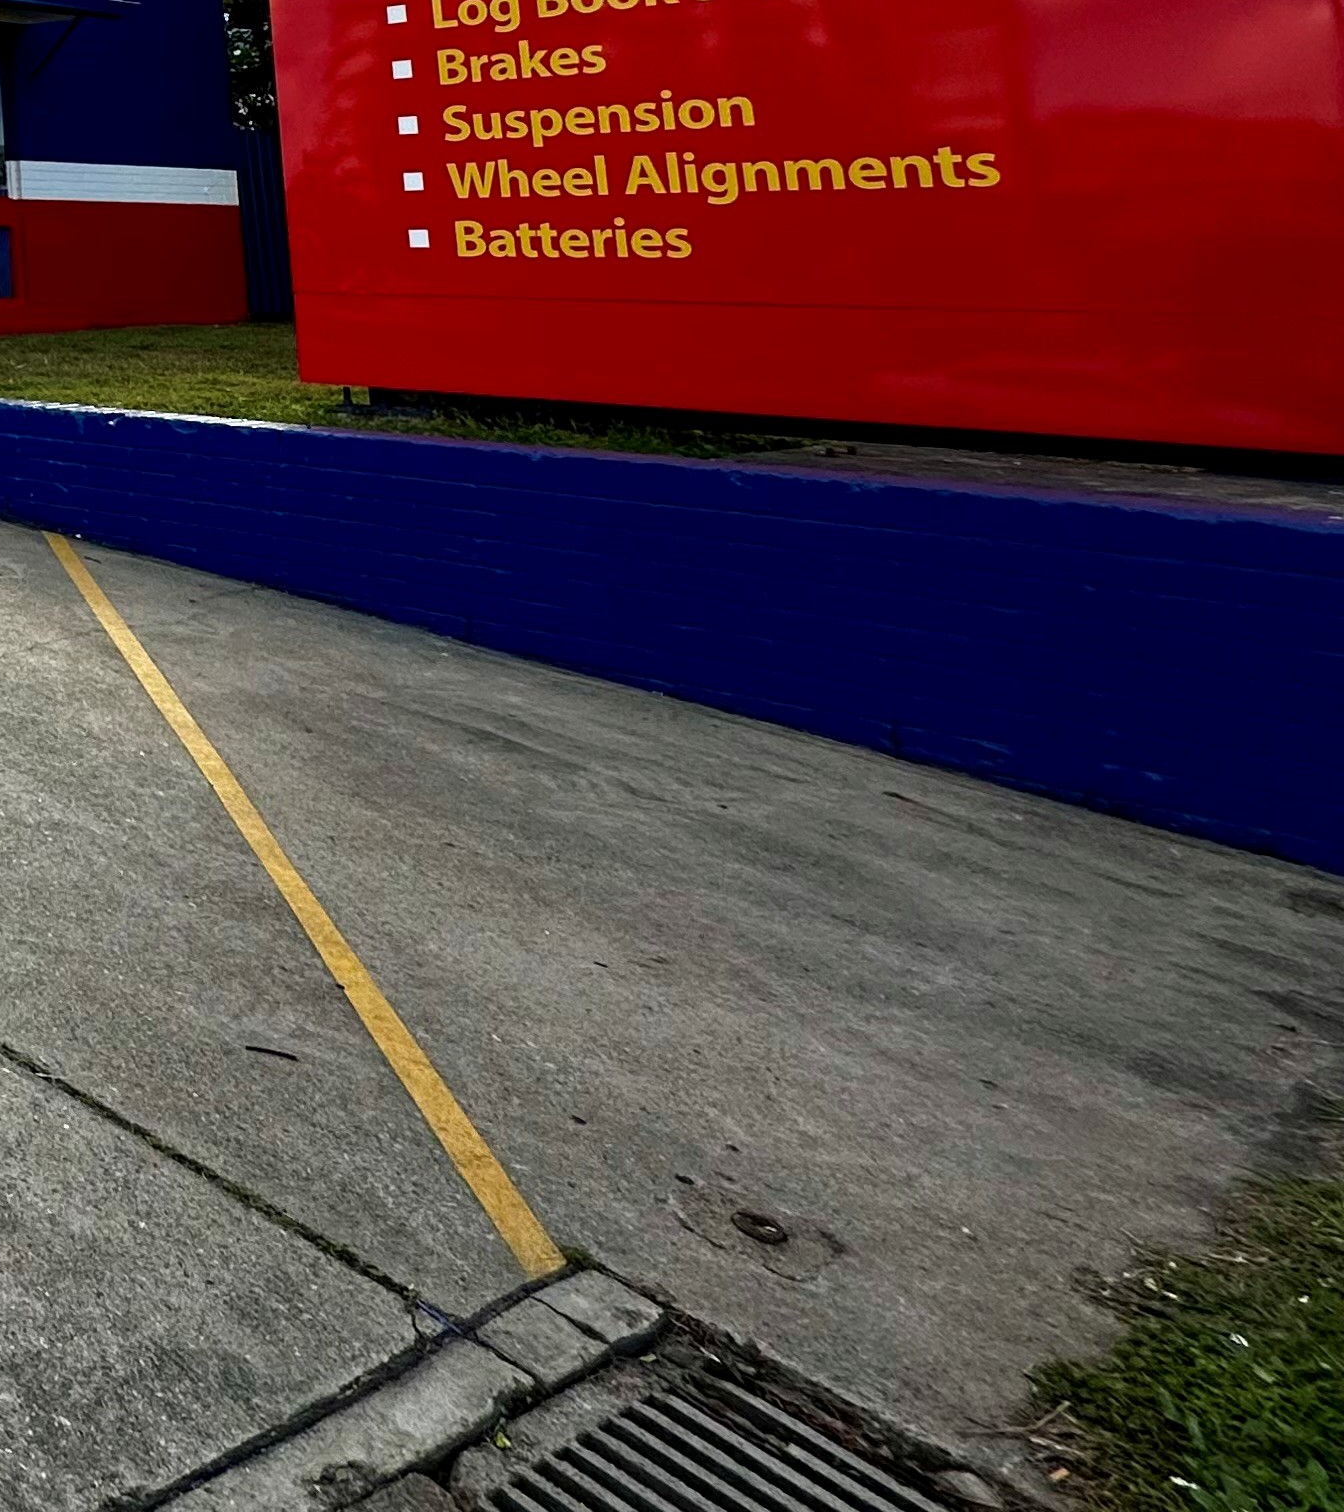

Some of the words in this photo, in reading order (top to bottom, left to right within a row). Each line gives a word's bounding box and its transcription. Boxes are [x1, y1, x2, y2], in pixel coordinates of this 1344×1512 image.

[437, 40, 607, 85] Brakes
[443, 90, 755, 147] Suspension
[447, 155, 609, 199] Wheel
[625, 146, 1002, 205] Alignments
[454, 217, 693, 259] Batteries
